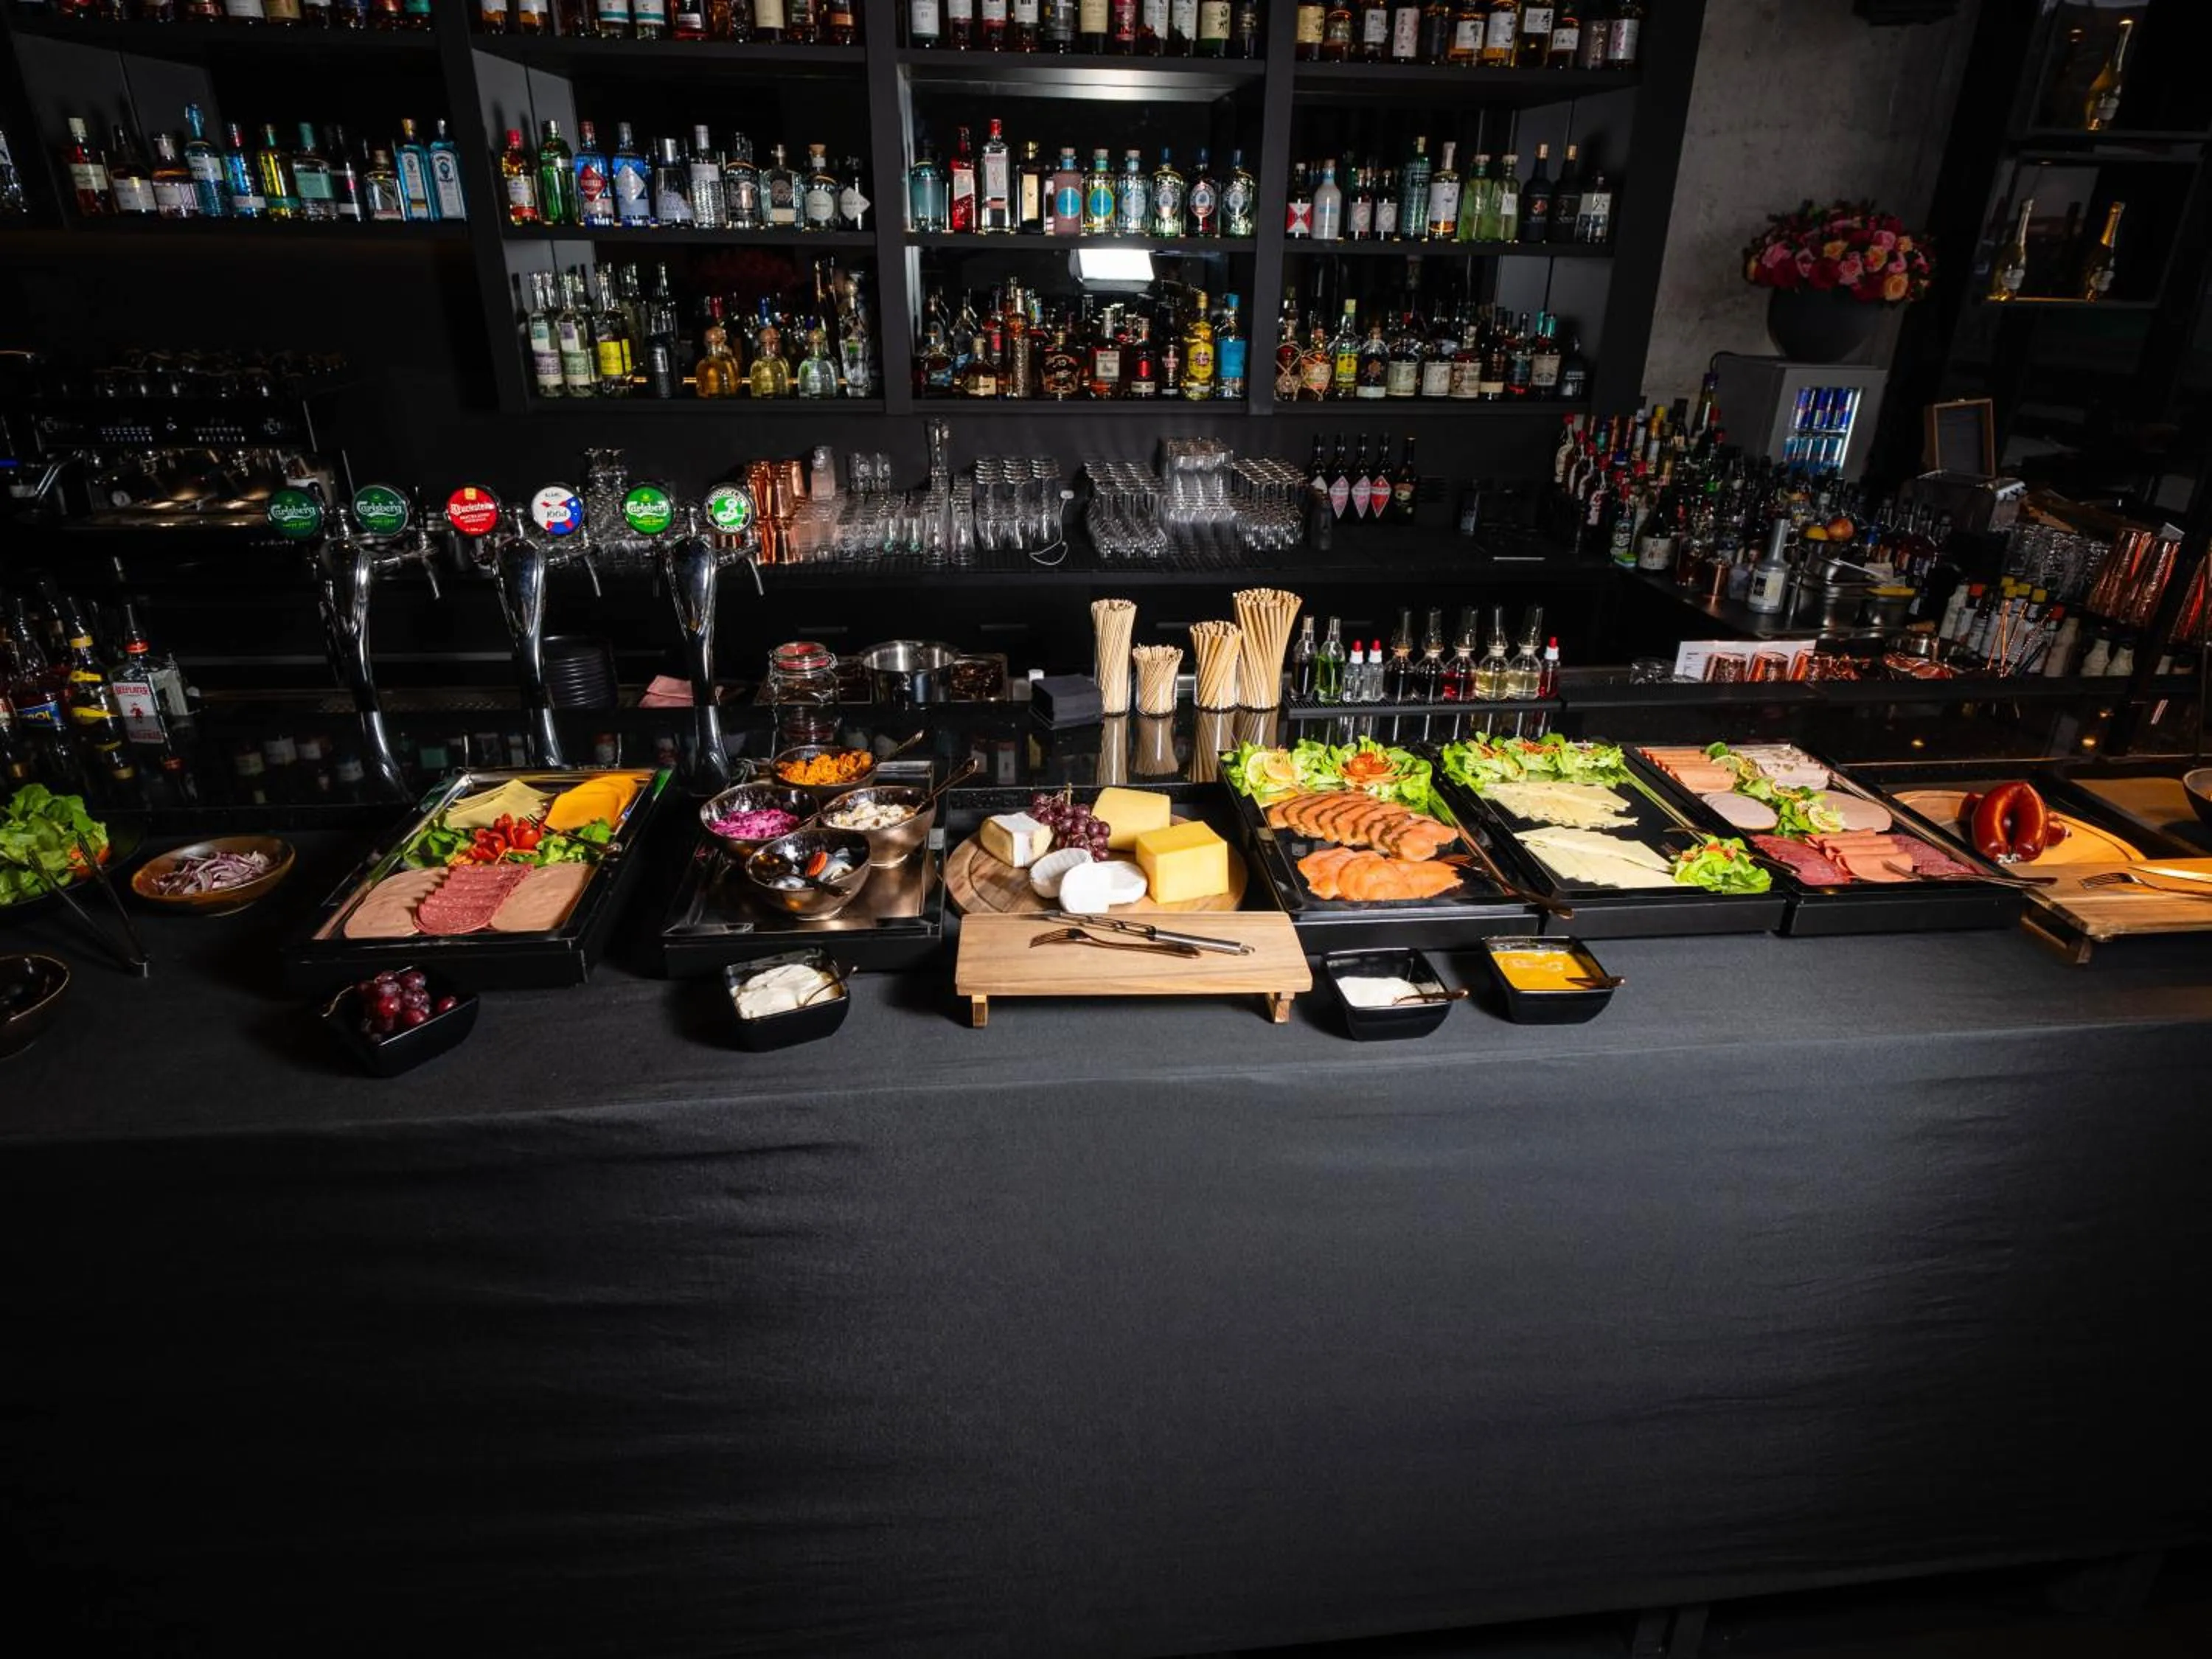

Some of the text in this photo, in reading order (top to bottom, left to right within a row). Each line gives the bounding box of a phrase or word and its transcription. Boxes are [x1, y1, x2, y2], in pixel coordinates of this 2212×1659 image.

[271, 504, 316, 521] Carlsberg
[357, 501, 403, 518] Carlsberg
[626, 501, 669, 518] Carlsberg
